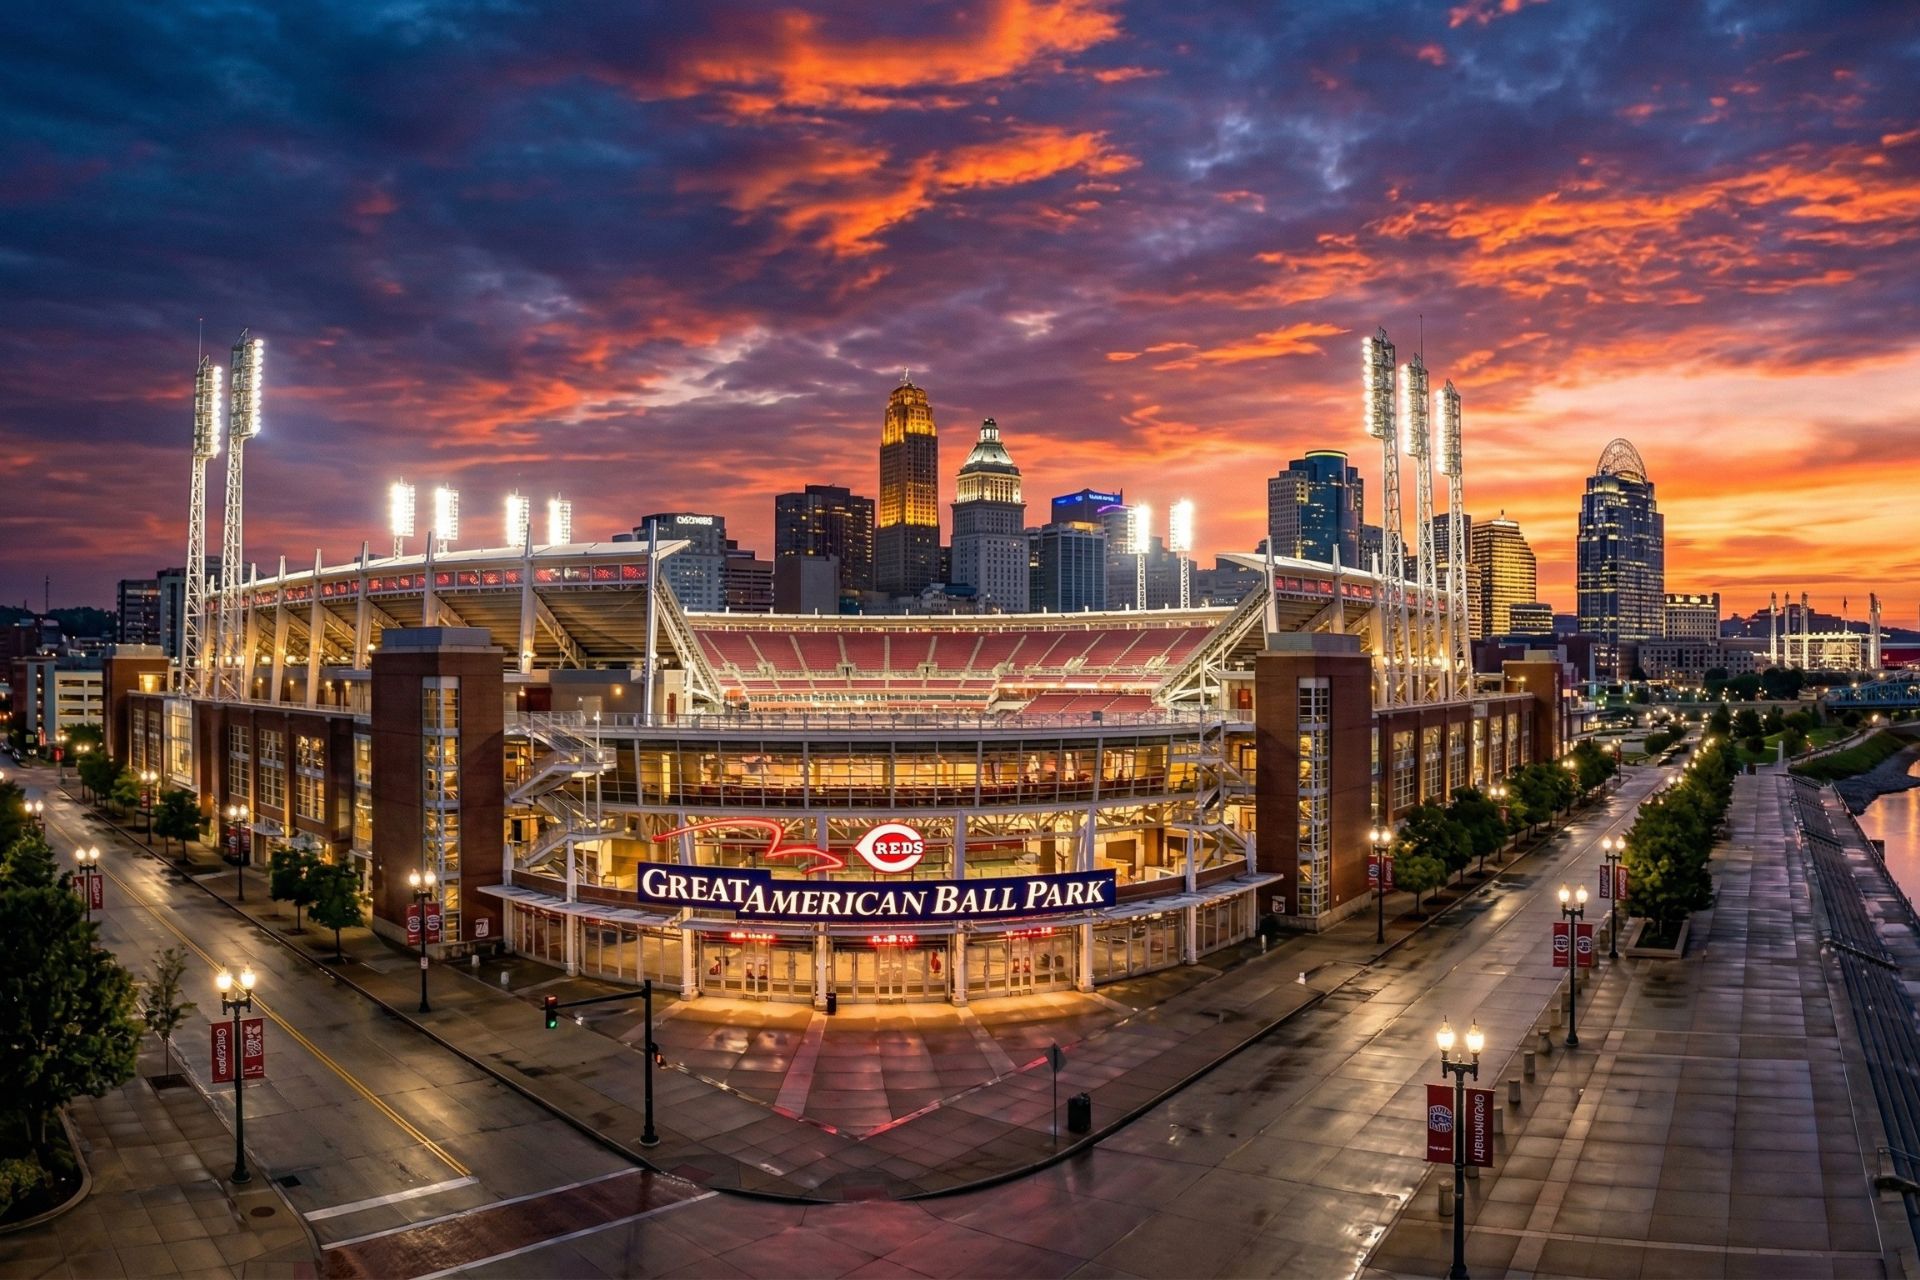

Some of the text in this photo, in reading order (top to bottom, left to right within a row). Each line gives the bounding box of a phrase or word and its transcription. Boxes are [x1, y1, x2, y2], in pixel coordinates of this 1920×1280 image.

[875, 841, 924, 855] REDS
[642, 868, 1106, 915] GREAT AMERICAN BALL PARK
